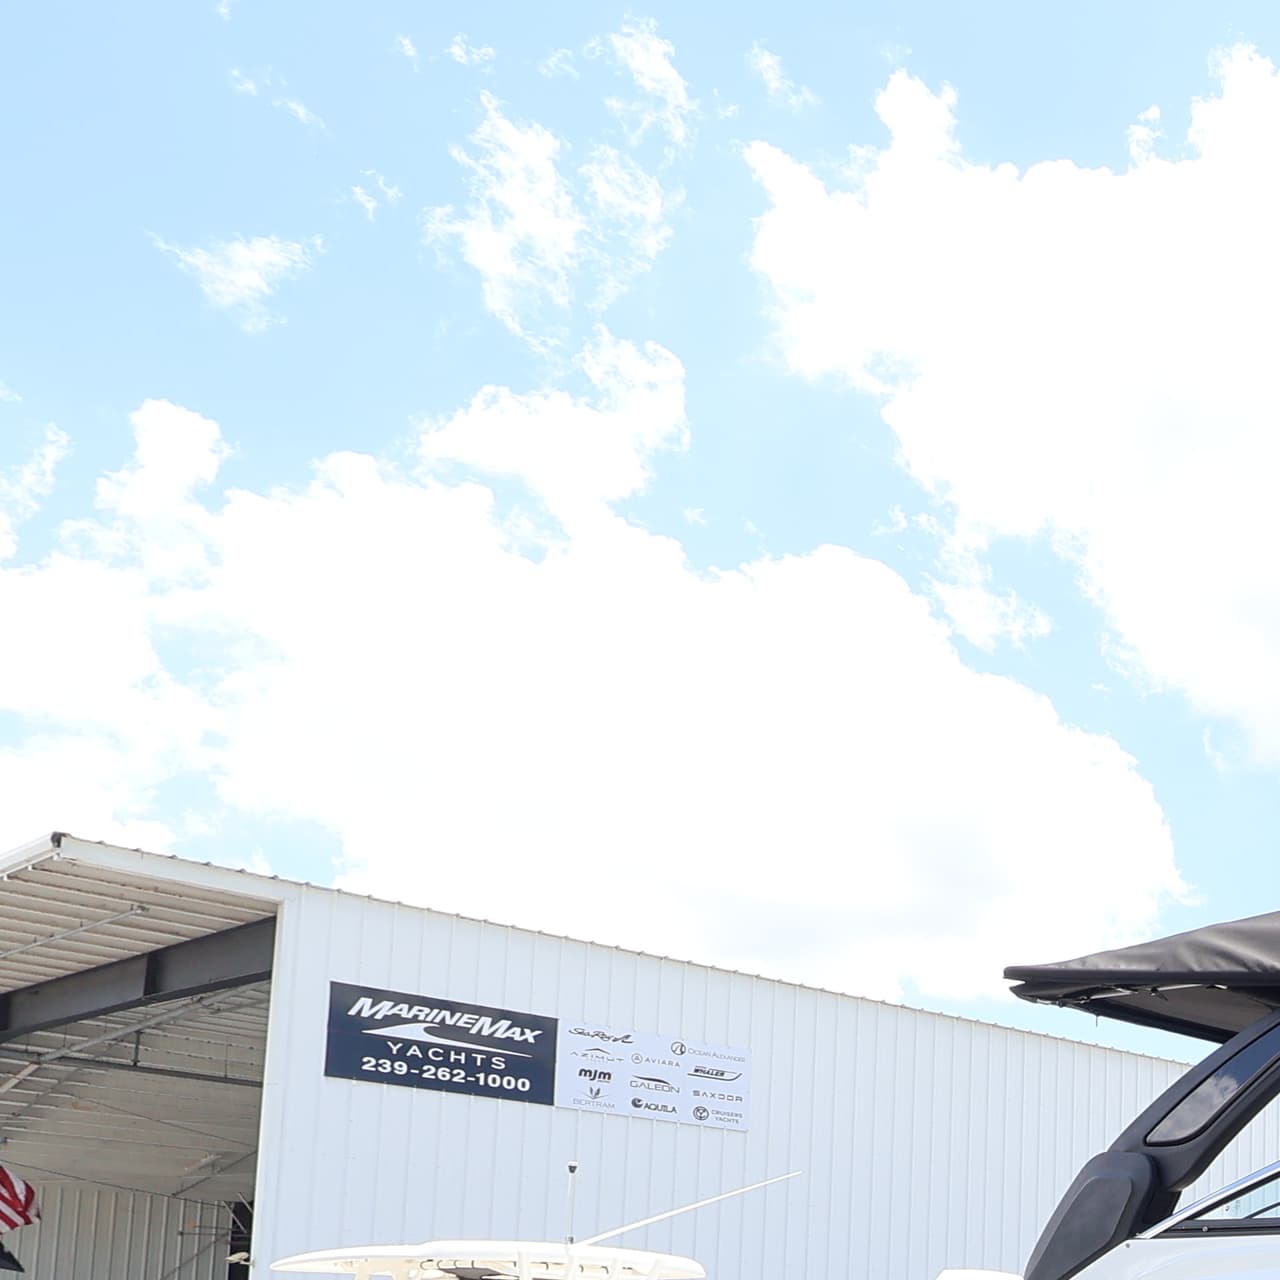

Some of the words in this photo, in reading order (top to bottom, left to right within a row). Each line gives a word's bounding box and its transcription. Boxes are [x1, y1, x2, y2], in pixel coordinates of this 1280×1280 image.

[387, 1041, 506, 1070] YACHTS
[644, 1057, 681, 1067] AVIARA
[361, 1056, 531, 1092] 239-262-1000
[578, 1068, 612, 1081] mjm
[629, 1080, 680, 1094] GALEON
[643, 1102, 678, 1114] AQUILA
